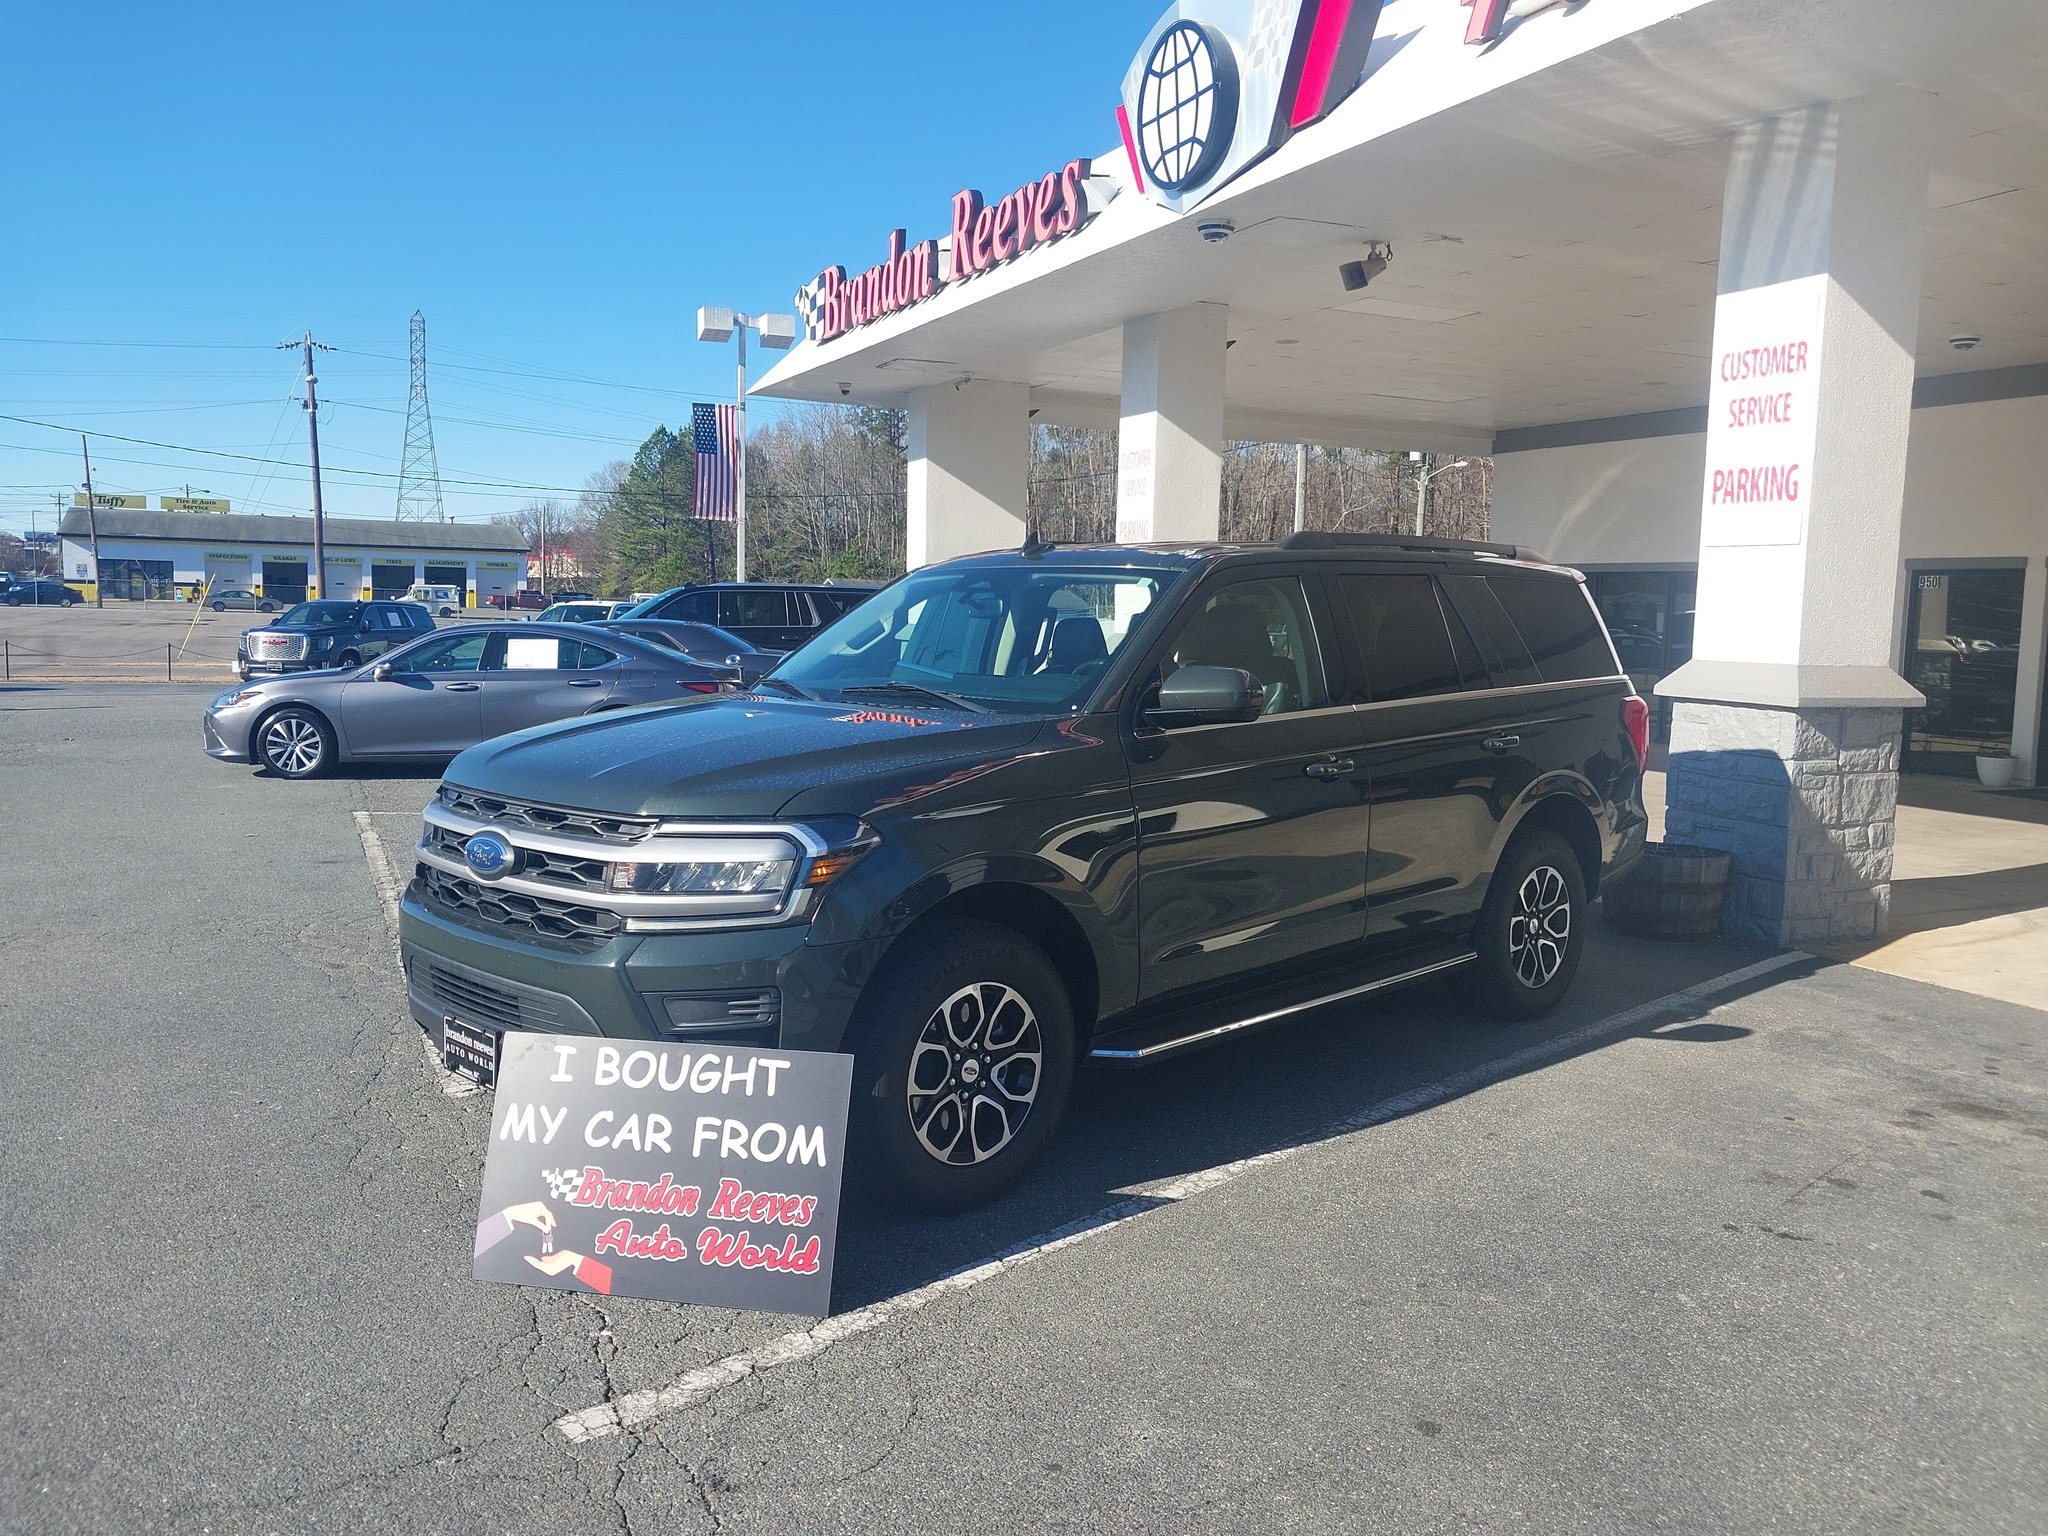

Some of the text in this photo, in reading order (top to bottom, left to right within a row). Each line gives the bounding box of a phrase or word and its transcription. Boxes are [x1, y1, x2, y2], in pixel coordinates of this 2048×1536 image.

[822, 157, 1092, 340] Brandon Reeves
[1721, 340, 1809, 383] CUSTOMER
[1728, 391, 1793, 429] SERVICE
[1121, 449, 1151, 470] CUSTOMER
[95, 495, 126, 507] Tuffy
[1124, 478, 1147, 497] SERVICE
[1711, 463, 1800, 506] PARKING
[1119, 519, 1149, 542] PARKING
[445, 1043, 493, 1071] AUTO WORLD
[549, 1045, 791, 1097] I BOUGHT
[499, 1102, 827, 1167] MY CAR FROM
[571, 1165, 817, 1227] Brandon Reeves
[594, 1218, 821, 1275] Auto World
